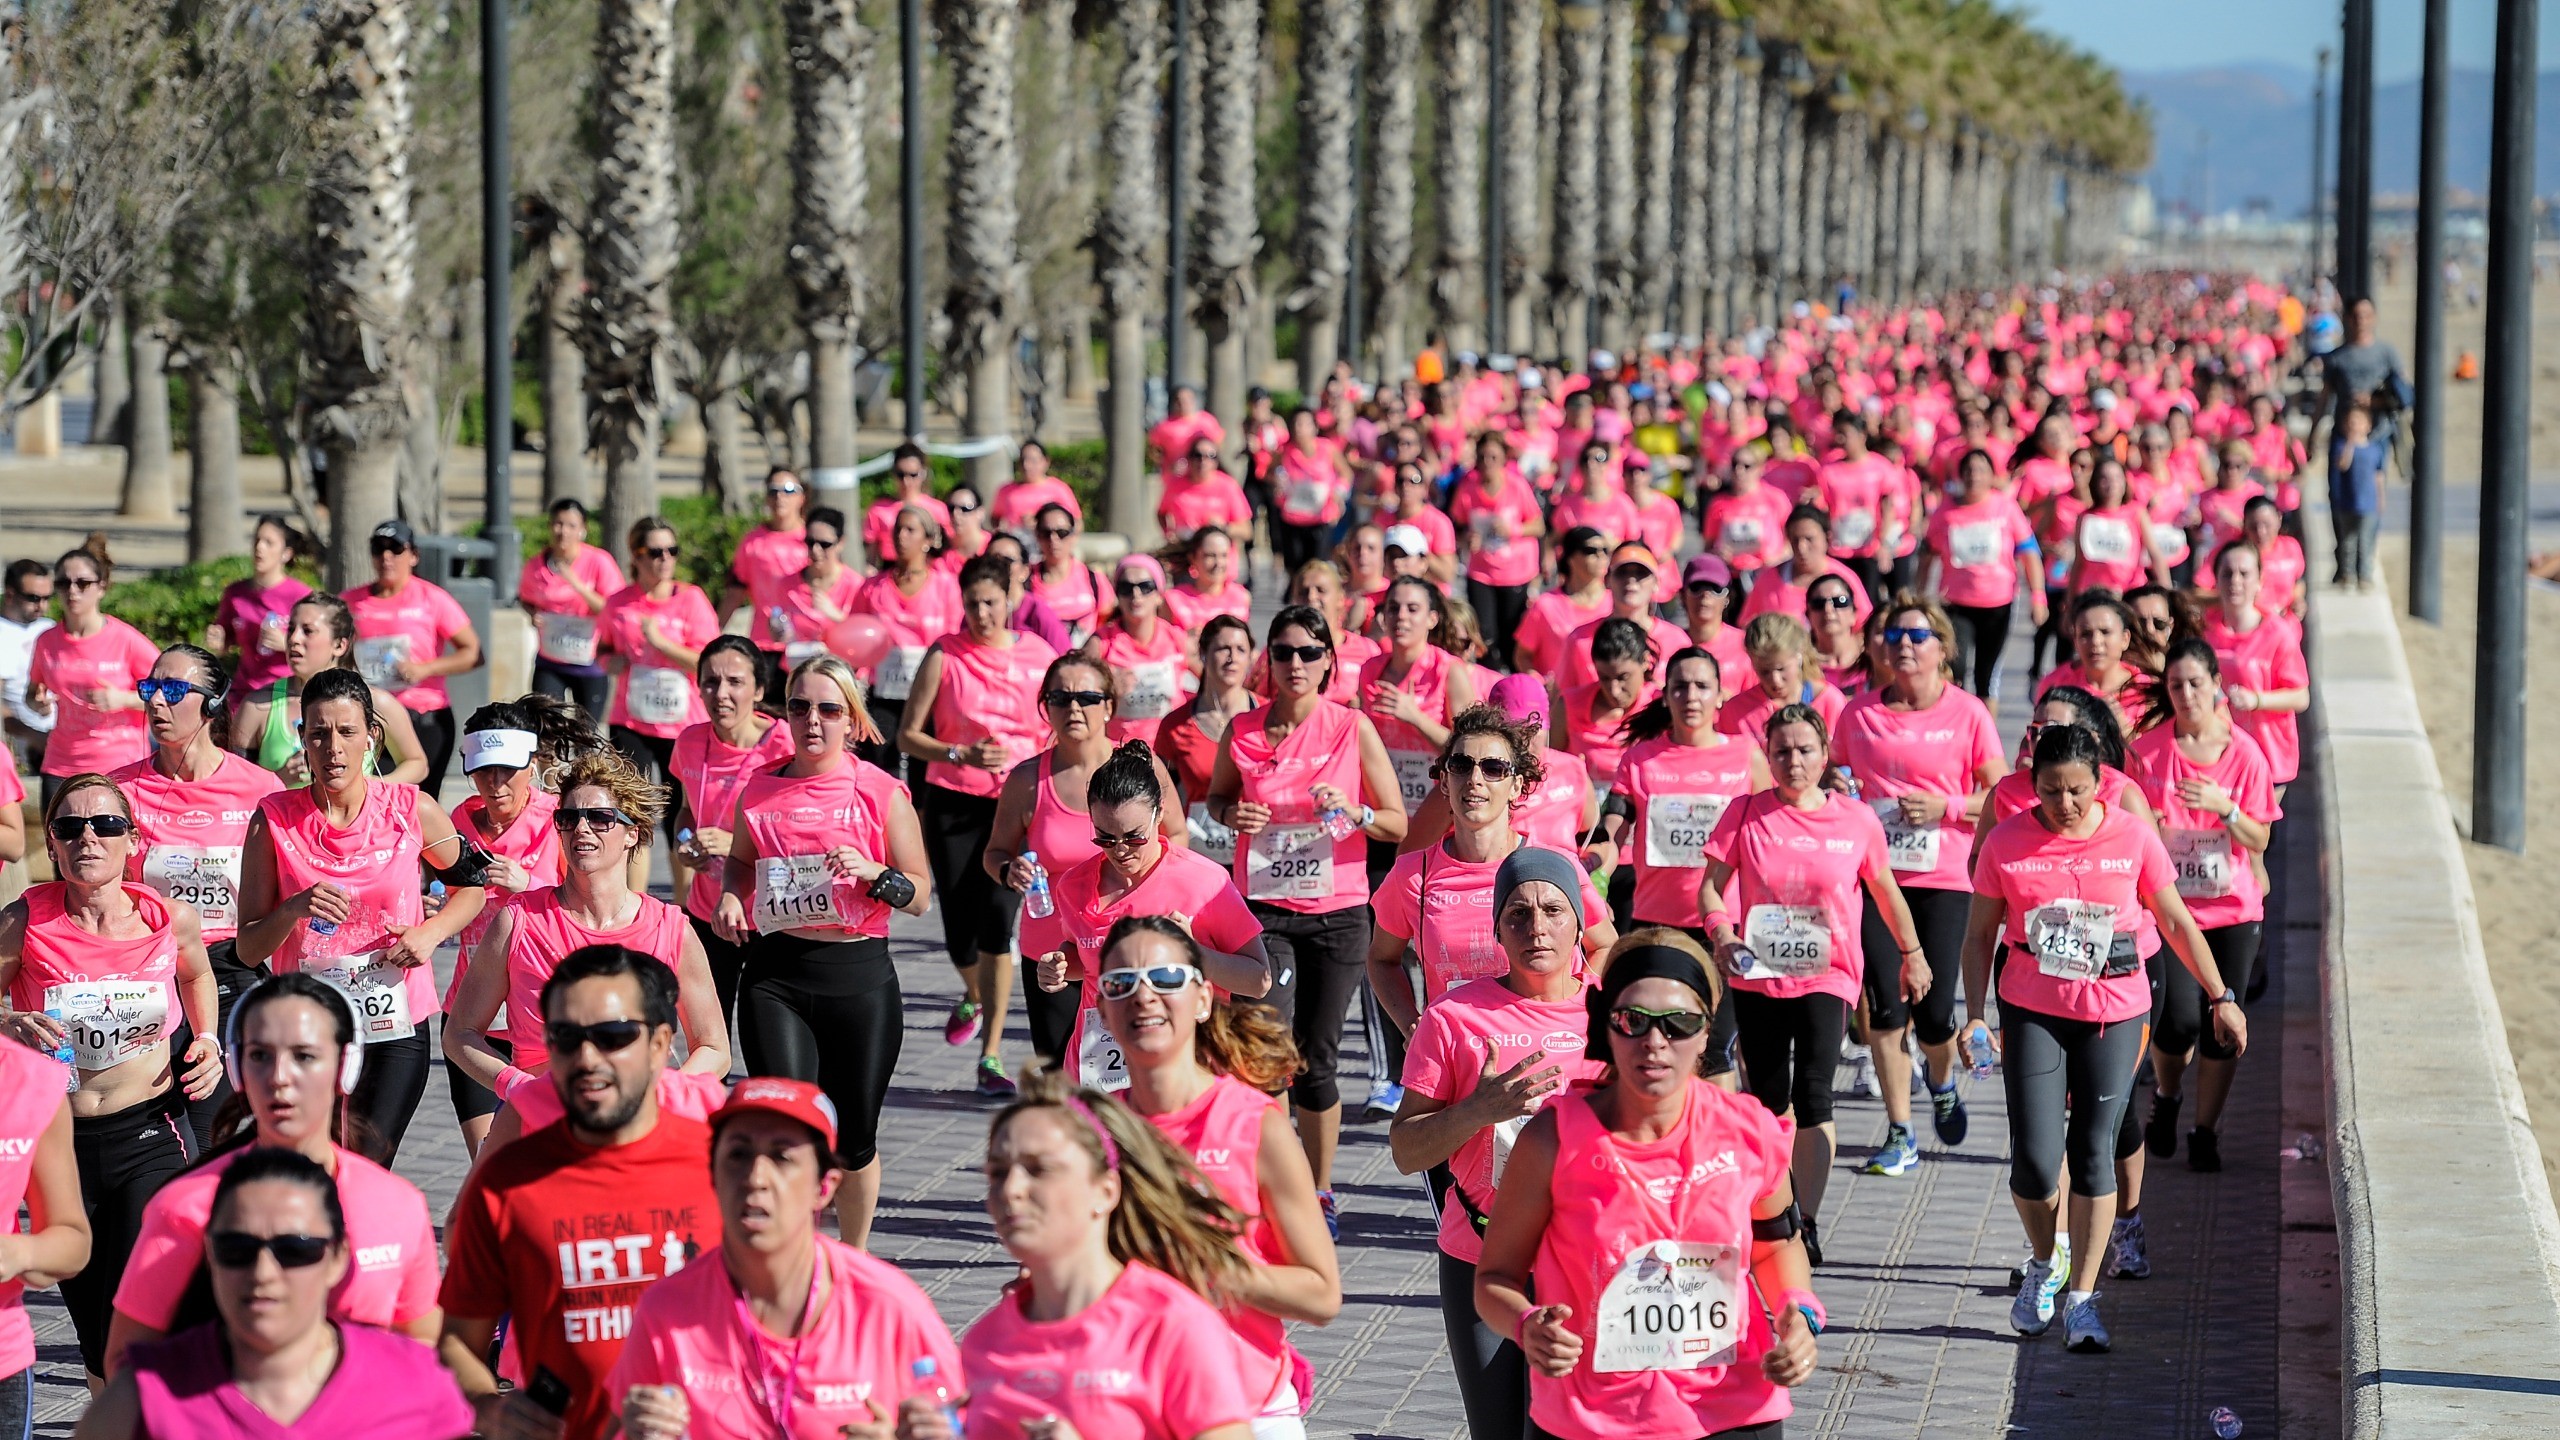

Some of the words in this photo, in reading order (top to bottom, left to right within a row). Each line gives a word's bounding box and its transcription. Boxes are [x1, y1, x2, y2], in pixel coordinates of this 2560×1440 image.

[1400, 783, 1425, 799] 39
[134, 811, 171, 825] YSHO
[1670, 830, 1712, 846] 623
[798, 866, 821, 874] DKV
[1271, 860, 1320, 877] 5282
[2007, 861, 2052, 872] OYSHO
[2101, 859, 2133, 870] DKV
[2175, 862, 2219, 879] 1861
[171, 885, 230, 905] 2953
[767, 894, 828, 916] 11119
[1768, 942, 1818, 958] 1256
[2041, 934, 2095, 959] 4839
[358, 962, 384, 973] DKV
[71, 1014, 104, 1023] Carrera
[116, 1007, 143, 1023] Mujer
[73, 1023, 159, 1049] 10122
[1469, 1034, 1532, 1049] OSHO
[1545, 1040, 1582, 1048] ASTURIANA
[1107, 1049, 1127, 1070] 2
[1097, 1076, 1128, 1085] OYSHO
[0, 1138, 34, 1154] KV
[1196, 1149, 1230, 1164] KV
[1692, 1151, 1735, 1180] DKV
[553, 1218, 575, 1240] IN
[583, 1211, 639, 1236] REAL
[649, 1206, 699, 1230] TIME
[356, 1244, 402, 1266] DKV
[558, 1234, 653, 1287] IRT
[1625, 1284, 1662, 1295] Carrera
[1678, 1276, 1708, 1297] Mujer
[564, 1305, 632, 1343] ETHI
[1624, 1301, 1728, 1335] 10016
[1617, 1345, 1661, 1354] OYSHO
[814, 1382, 872, 1403] DKV
